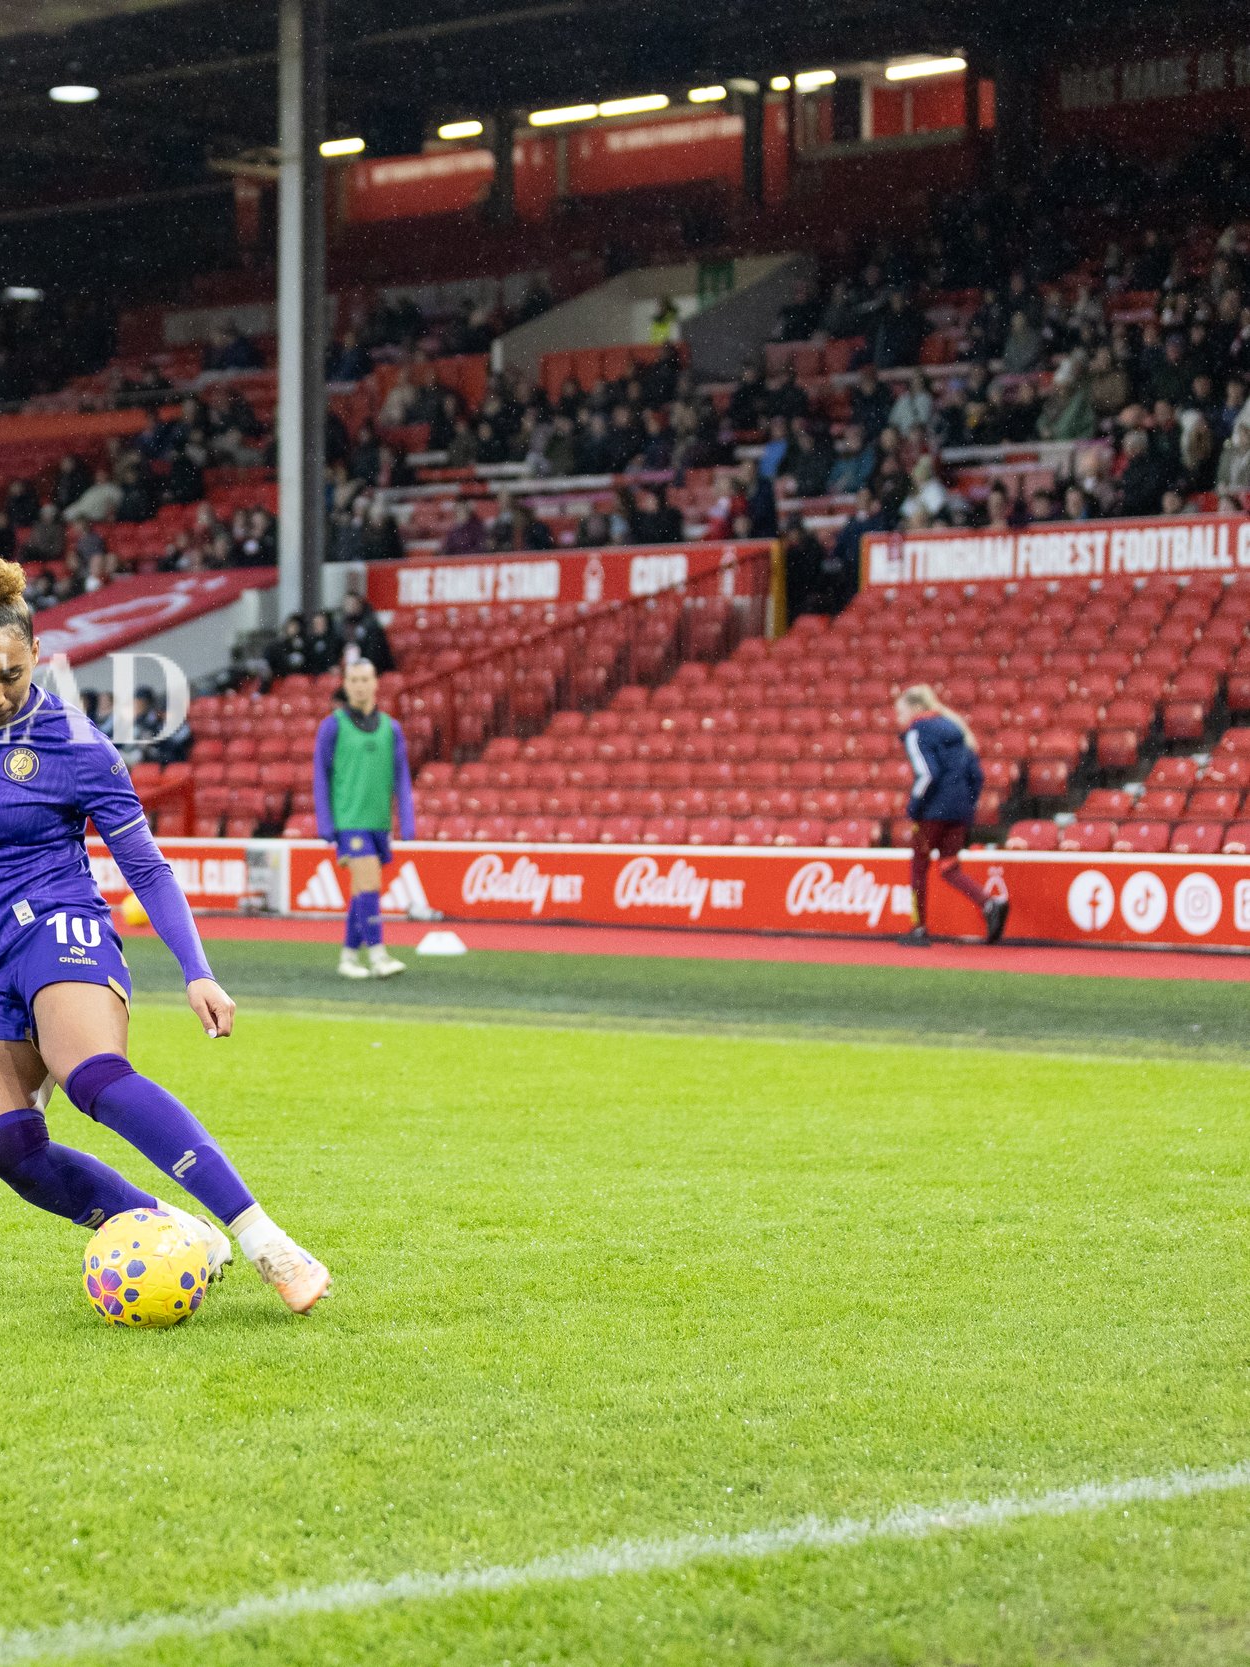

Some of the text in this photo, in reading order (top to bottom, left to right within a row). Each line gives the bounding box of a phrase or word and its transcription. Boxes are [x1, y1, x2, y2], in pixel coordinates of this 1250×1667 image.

[1016, 528, 1110, 578] FOREST
[1110, 523, 1233, 573] FOOTBALL
[397, 568, 431, 606] THE
[462, 854, 584, 915] Bally BET
[614, 857, 745, 920] Bally BET
[786, 861, 915, 928] Bally BE
[46, 912, 102, 947] 10
